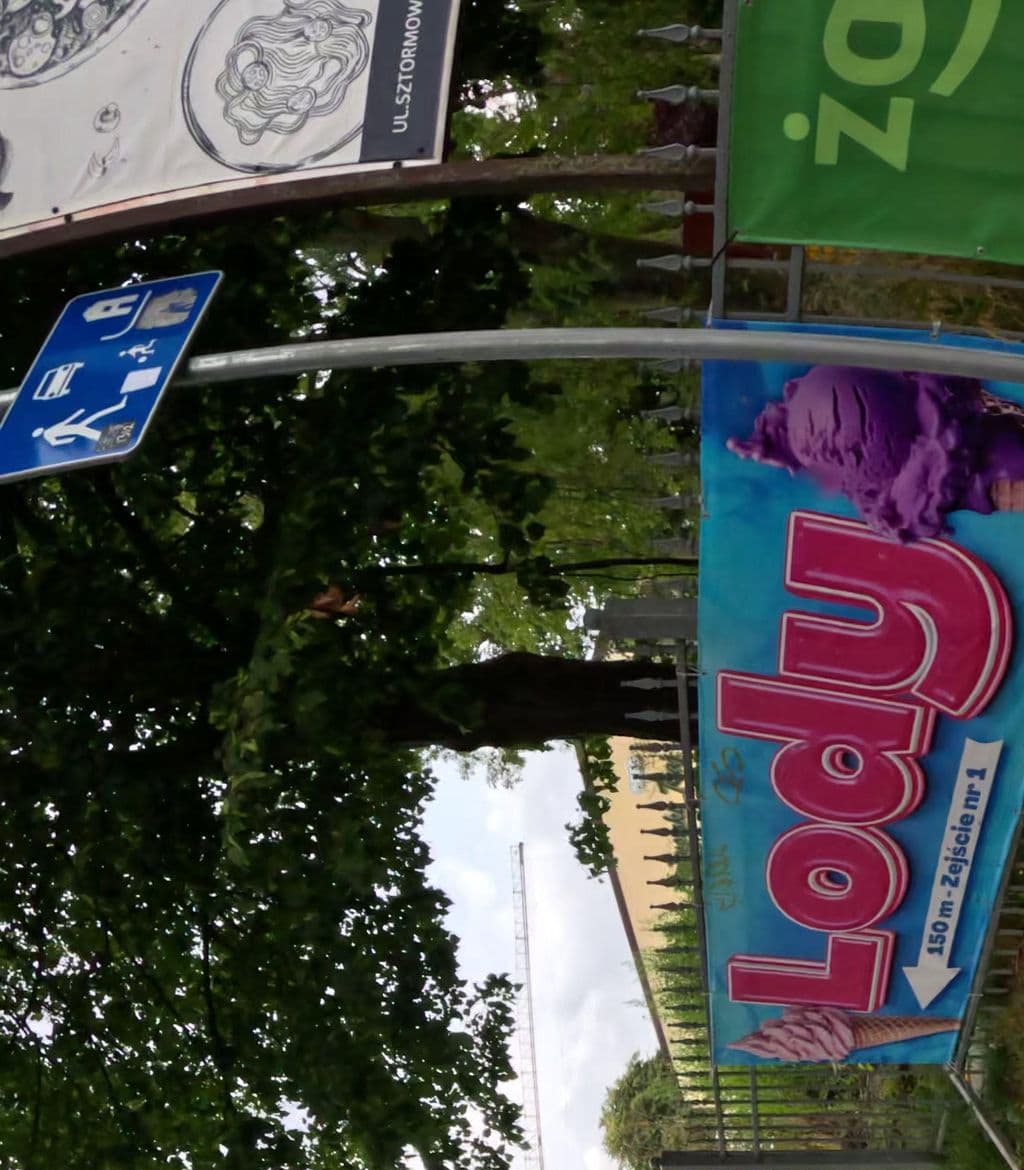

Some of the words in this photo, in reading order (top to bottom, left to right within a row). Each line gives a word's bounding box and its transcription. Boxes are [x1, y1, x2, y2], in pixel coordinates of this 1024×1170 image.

[716, 509, 1013, 1013] Lody
[965, 767, 988, 780] 1
[962, 782, 981, 809] nr
[940, 813, 975, 887] Zejście
[937, 900, 954, 917] m
[927, 920, 949, 955] 150
